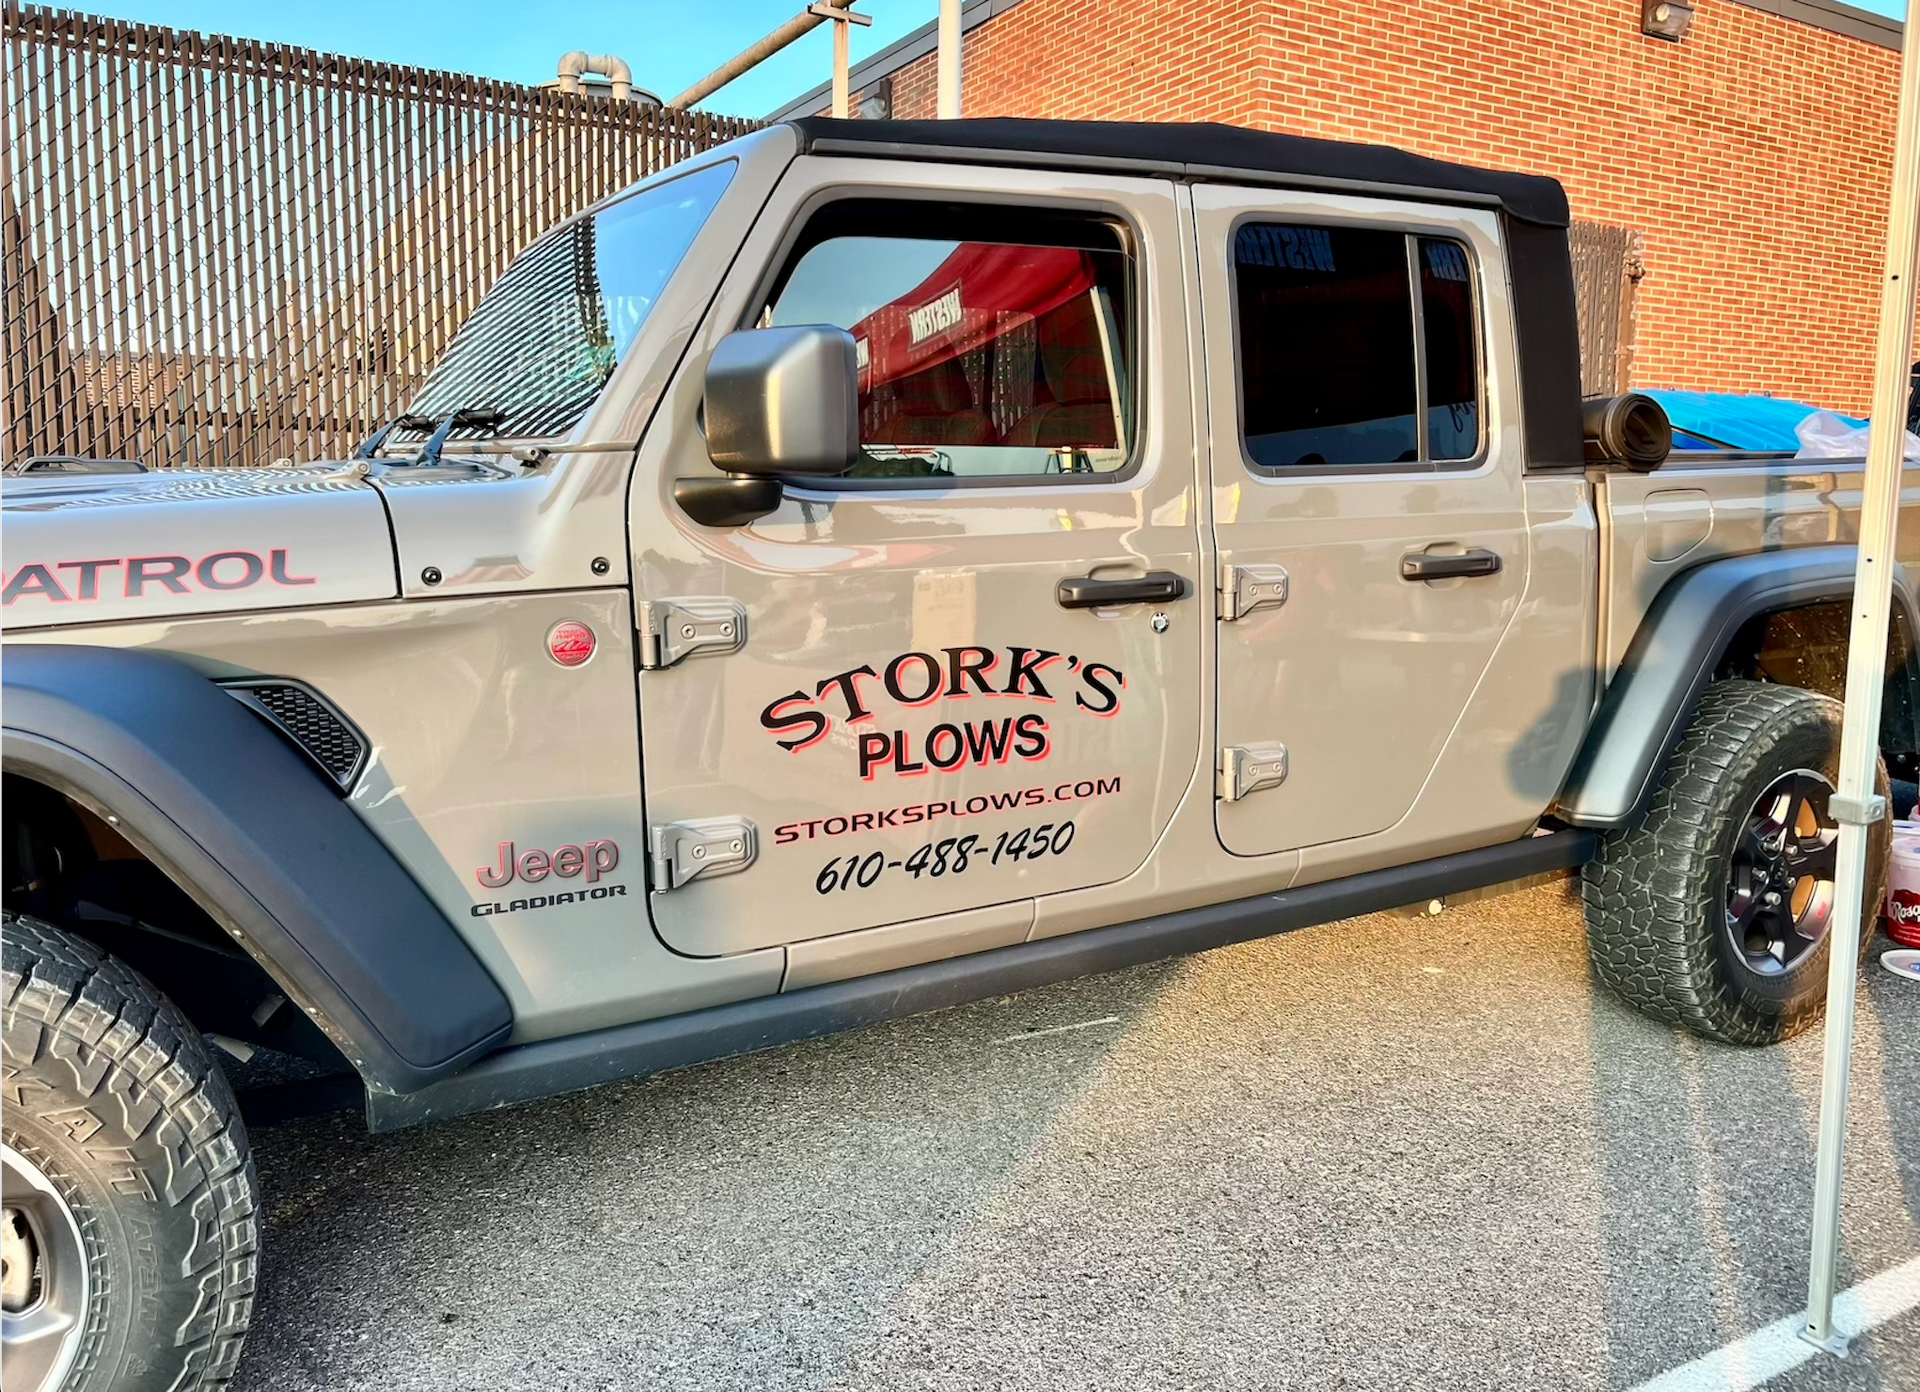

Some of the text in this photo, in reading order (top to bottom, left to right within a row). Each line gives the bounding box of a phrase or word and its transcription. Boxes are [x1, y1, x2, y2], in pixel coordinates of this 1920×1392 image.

[2, 549, 316, 606] ATROL
[760, 646, 1126, 754] STORK'S
[858, 713, 1052, 781] PLOWS
[773, 776, 1124, 845] STORKSPLOWS.COM
[476, 839, 619, 888] Jeep
[815, 820, 1076, 896] 610-488-1450
[470, 884, 628, 918] GLADIATOR
